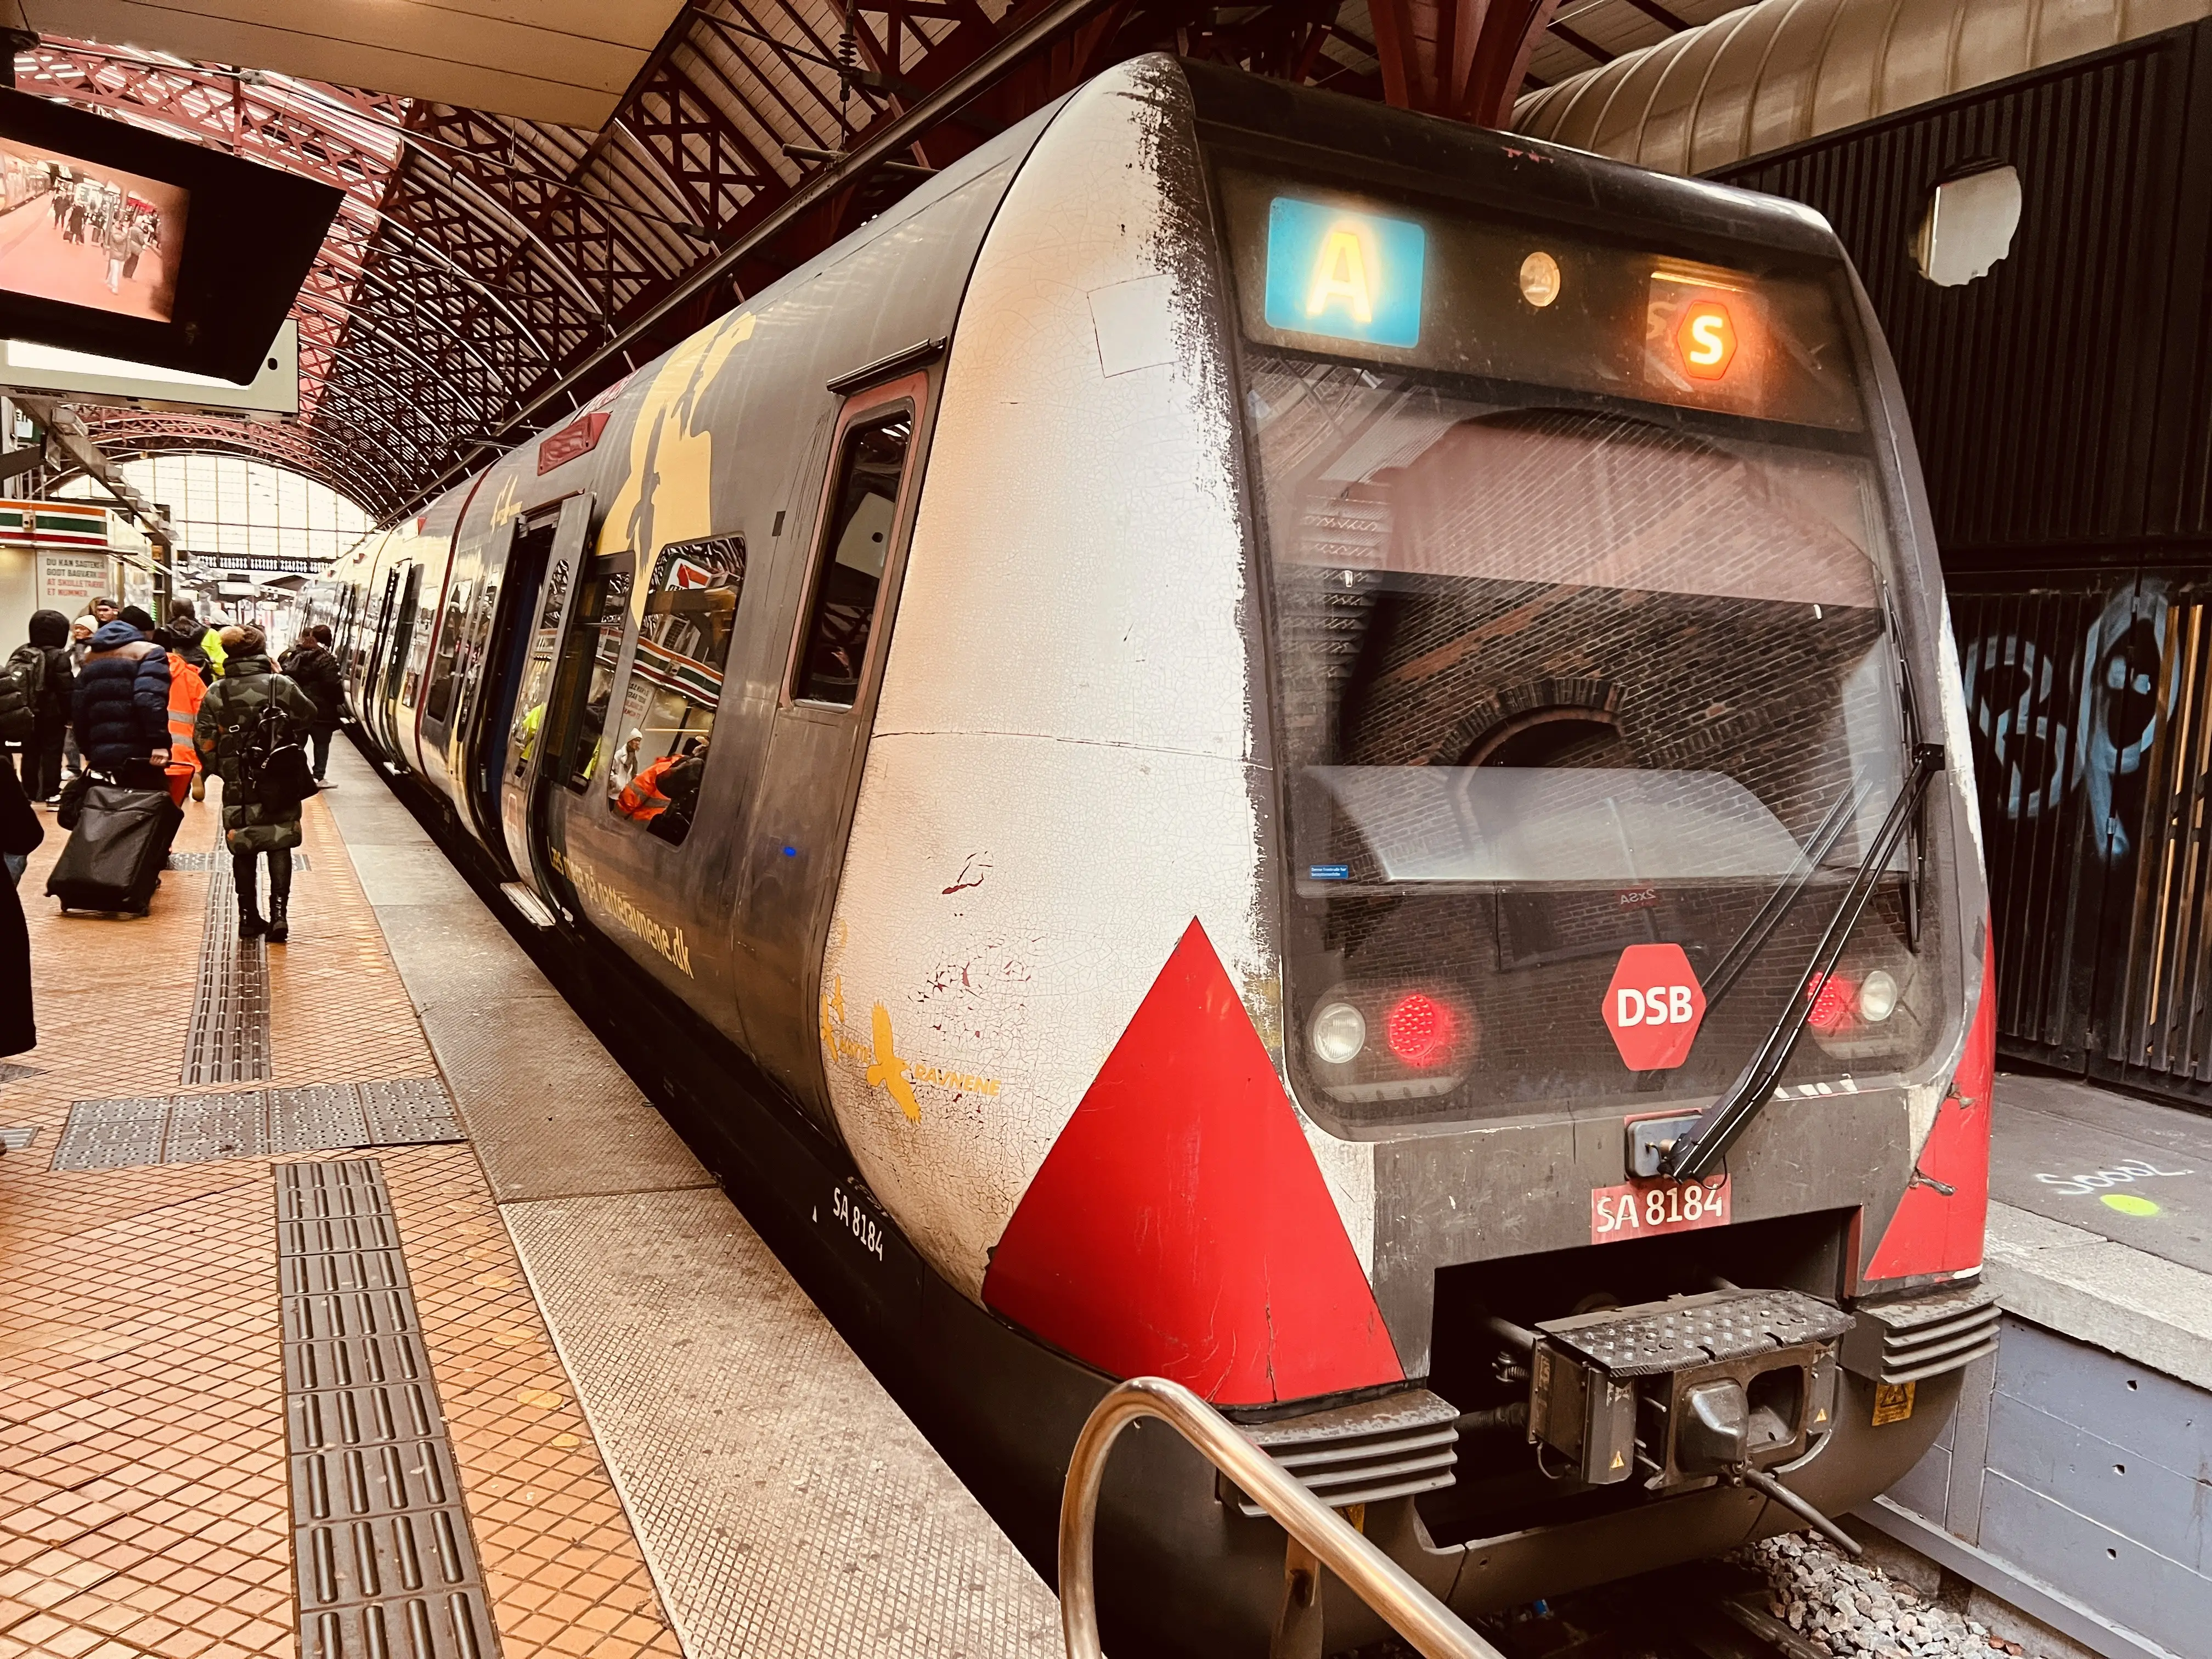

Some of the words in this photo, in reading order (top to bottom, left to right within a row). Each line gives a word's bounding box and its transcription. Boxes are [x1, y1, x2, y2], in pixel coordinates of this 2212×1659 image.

[1305, 232, 1373, 323] A
[1690, 315, 1724, 365] S
[1617, 985, 1694, 1028] DSB
[913, 1063, 1002, 1097] RAVNENE
[833, 1187, 849, 1227] SA
[852, 1205, 883, 1262] 8184
[1596, 1194, 1640, 1233] SA
[1645, 1183, 1723, 1226] 8184
